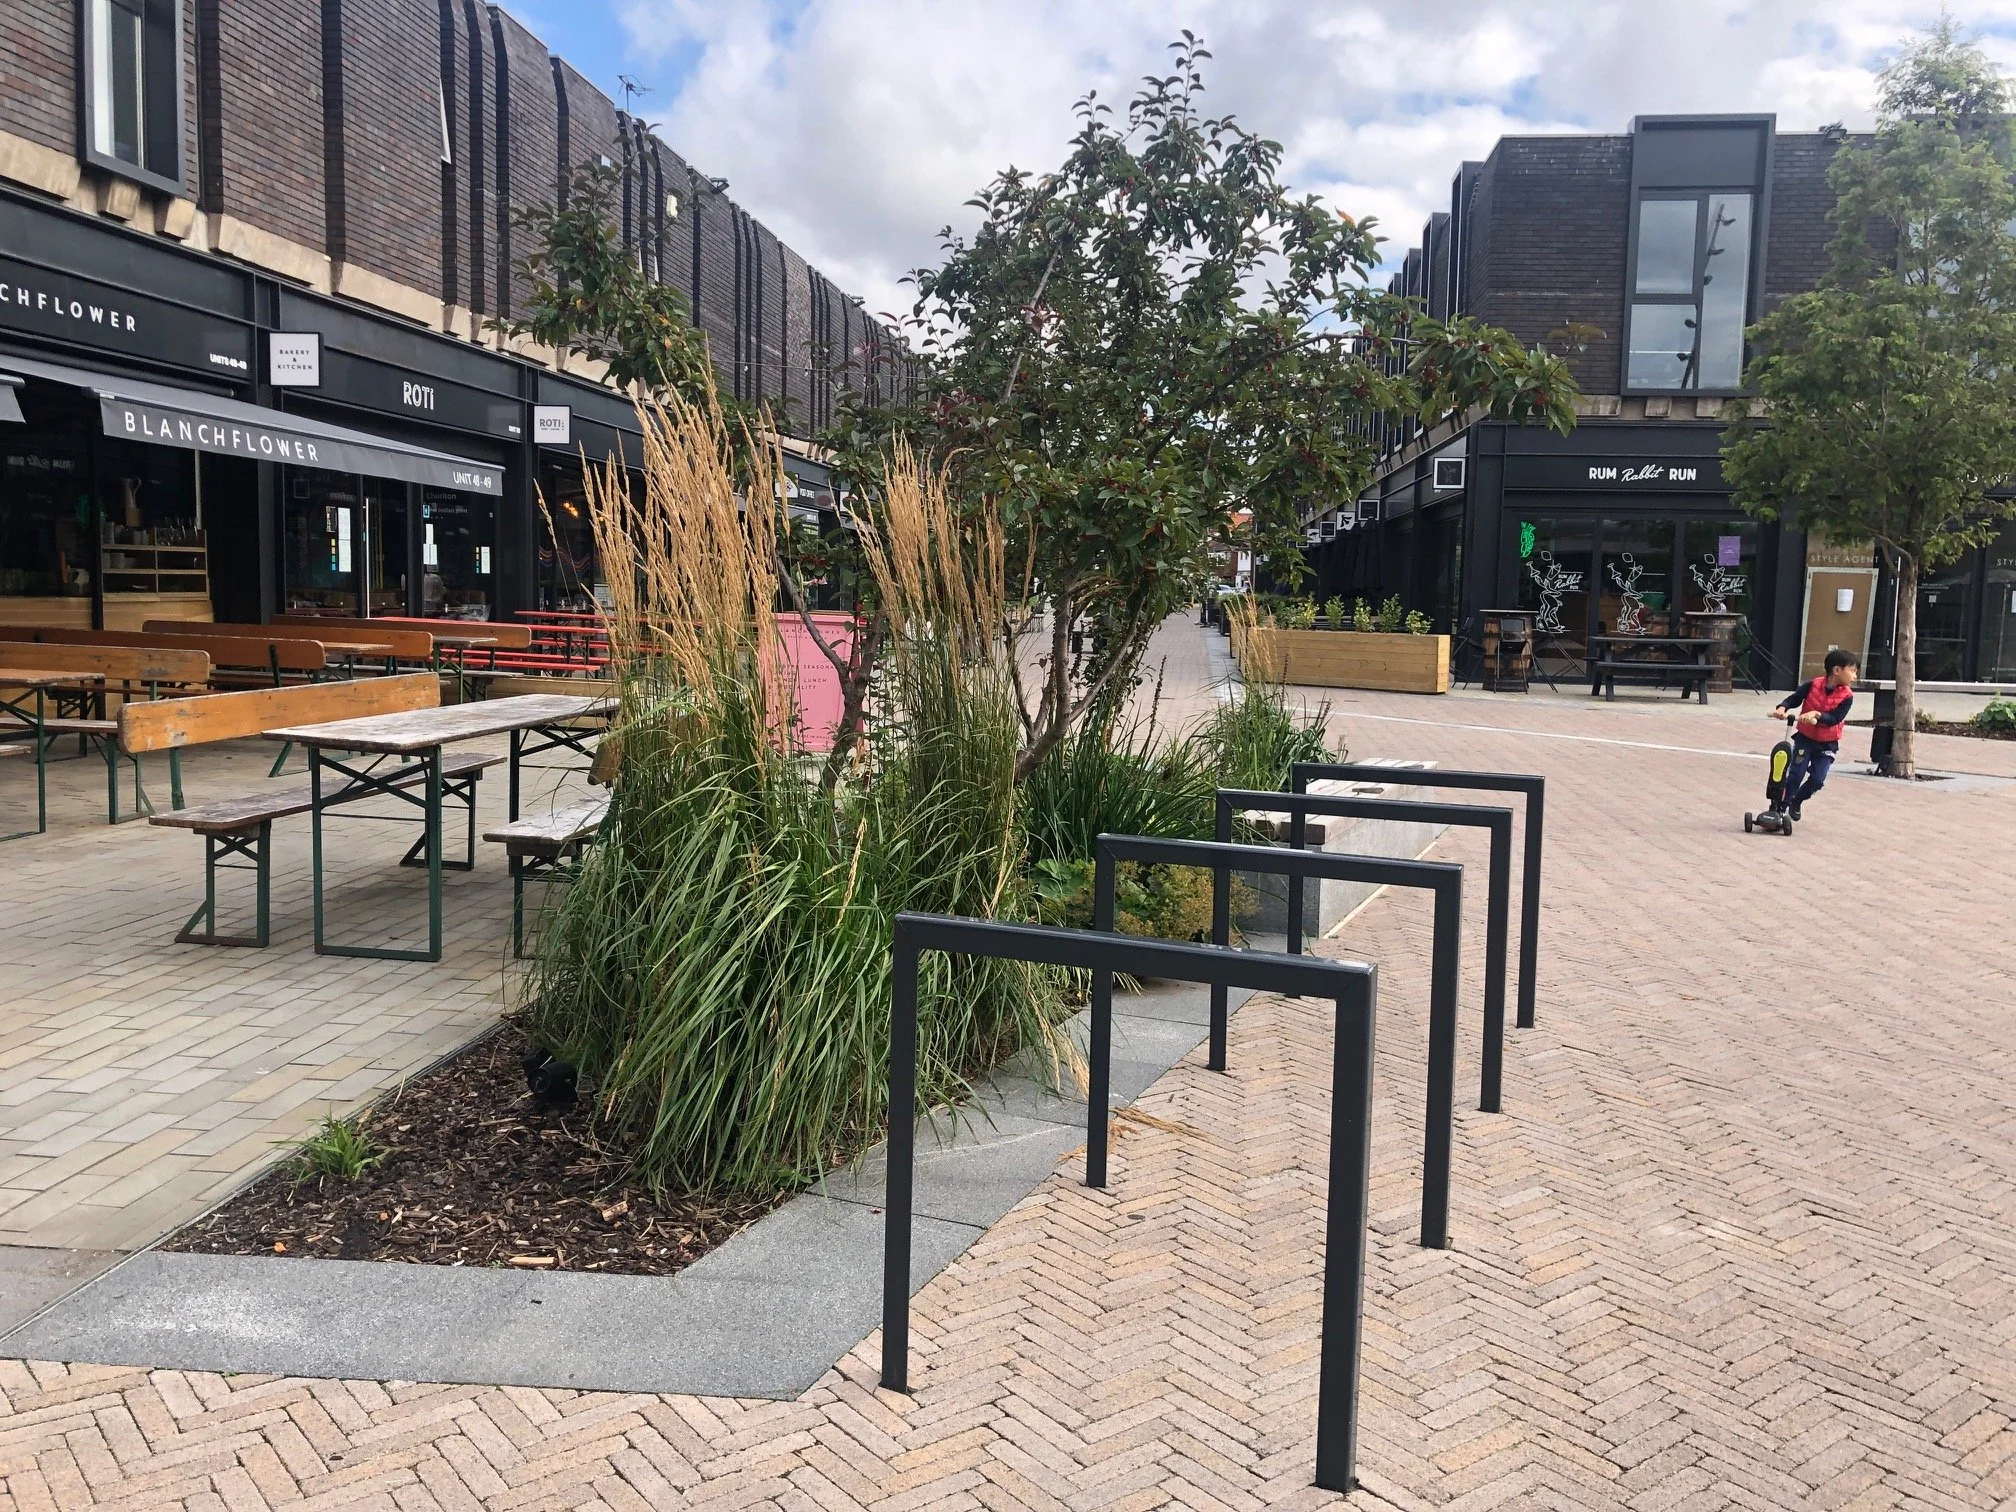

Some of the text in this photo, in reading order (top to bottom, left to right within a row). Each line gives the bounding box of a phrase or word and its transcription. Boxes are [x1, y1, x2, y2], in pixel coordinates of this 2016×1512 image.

[0, 283, 136, 332] CHFLOWER
[209, 353, 229, 366] UNITS
[539, 418, 560, 428] ROTI
[124, 411, 319, 462] BLANCHFLOWER
[452, 471, 472, 486] UNIT
[1588, 464, 1697, 482] RUM Rabbit RUN
[1810, 554, 1879, 564] STYLE AGENT
